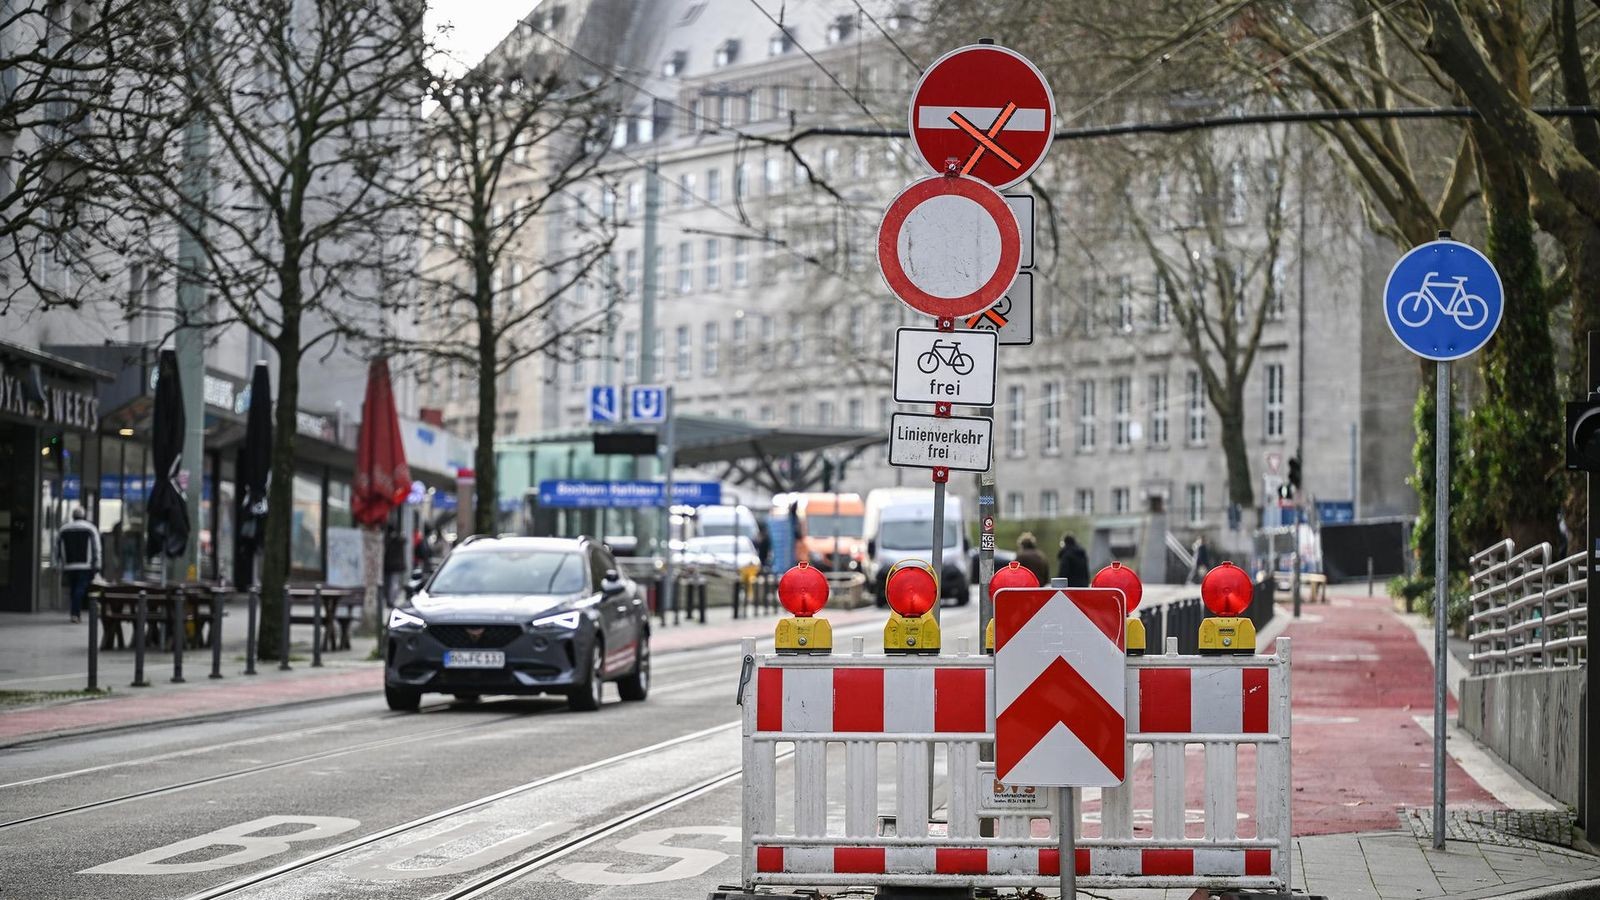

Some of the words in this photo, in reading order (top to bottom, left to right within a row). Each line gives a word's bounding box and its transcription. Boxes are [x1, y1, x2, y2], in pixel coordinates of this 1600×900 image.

[930, 379, 960, 395] frei
[42, 384, 99, 433] SWEETS
[636, 390, 658, 417] U
[898, 426, 983, 444] Linienverkehr
[928, 444, 949, 459] frei
